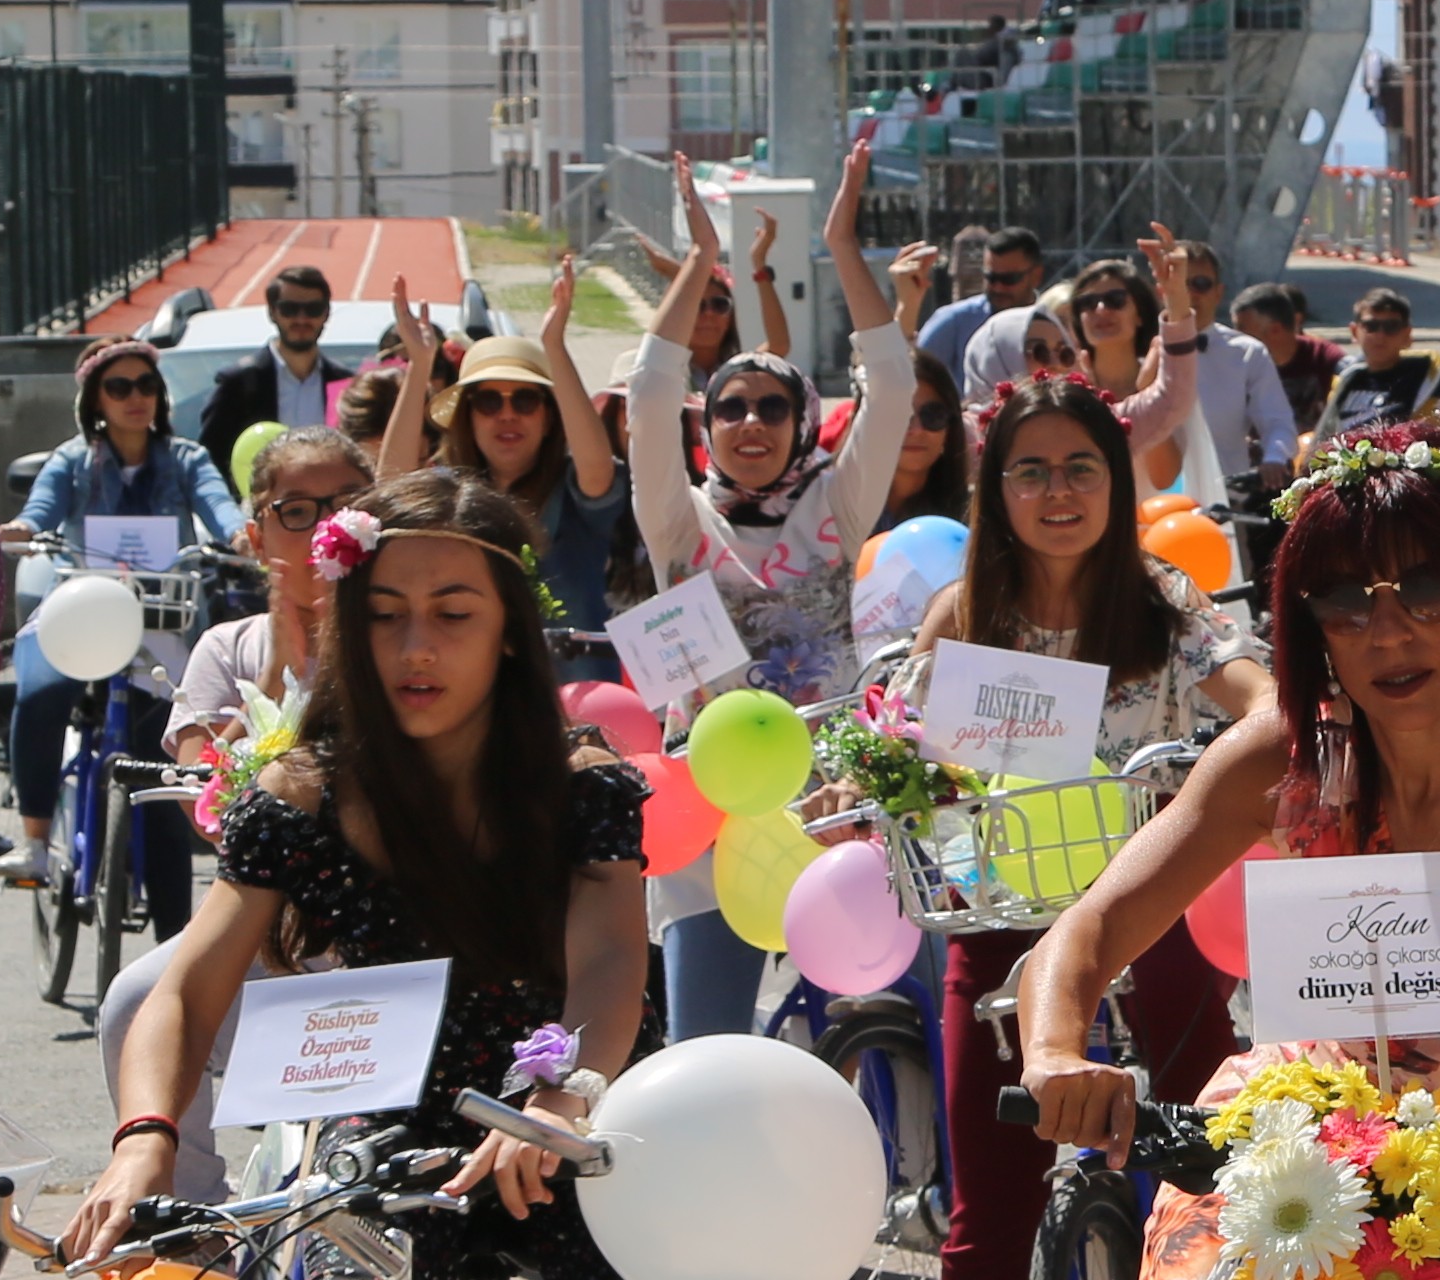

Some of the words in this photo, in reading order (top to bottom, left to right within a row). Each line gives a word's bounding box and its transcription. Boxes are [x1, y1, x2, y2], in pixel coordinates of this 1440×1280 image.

[1327, 901, 1431, 943] Kadın
[1309, 947, 1378, 971] sokağa
[1298, 976, 1374, 1004] dünya
[304, 1009, 381, 1034] Süslüyüz
[300, 1034, 372, 1061] Özgürüz
[281, 1057, 378, 1083] Bisikletliyiz
